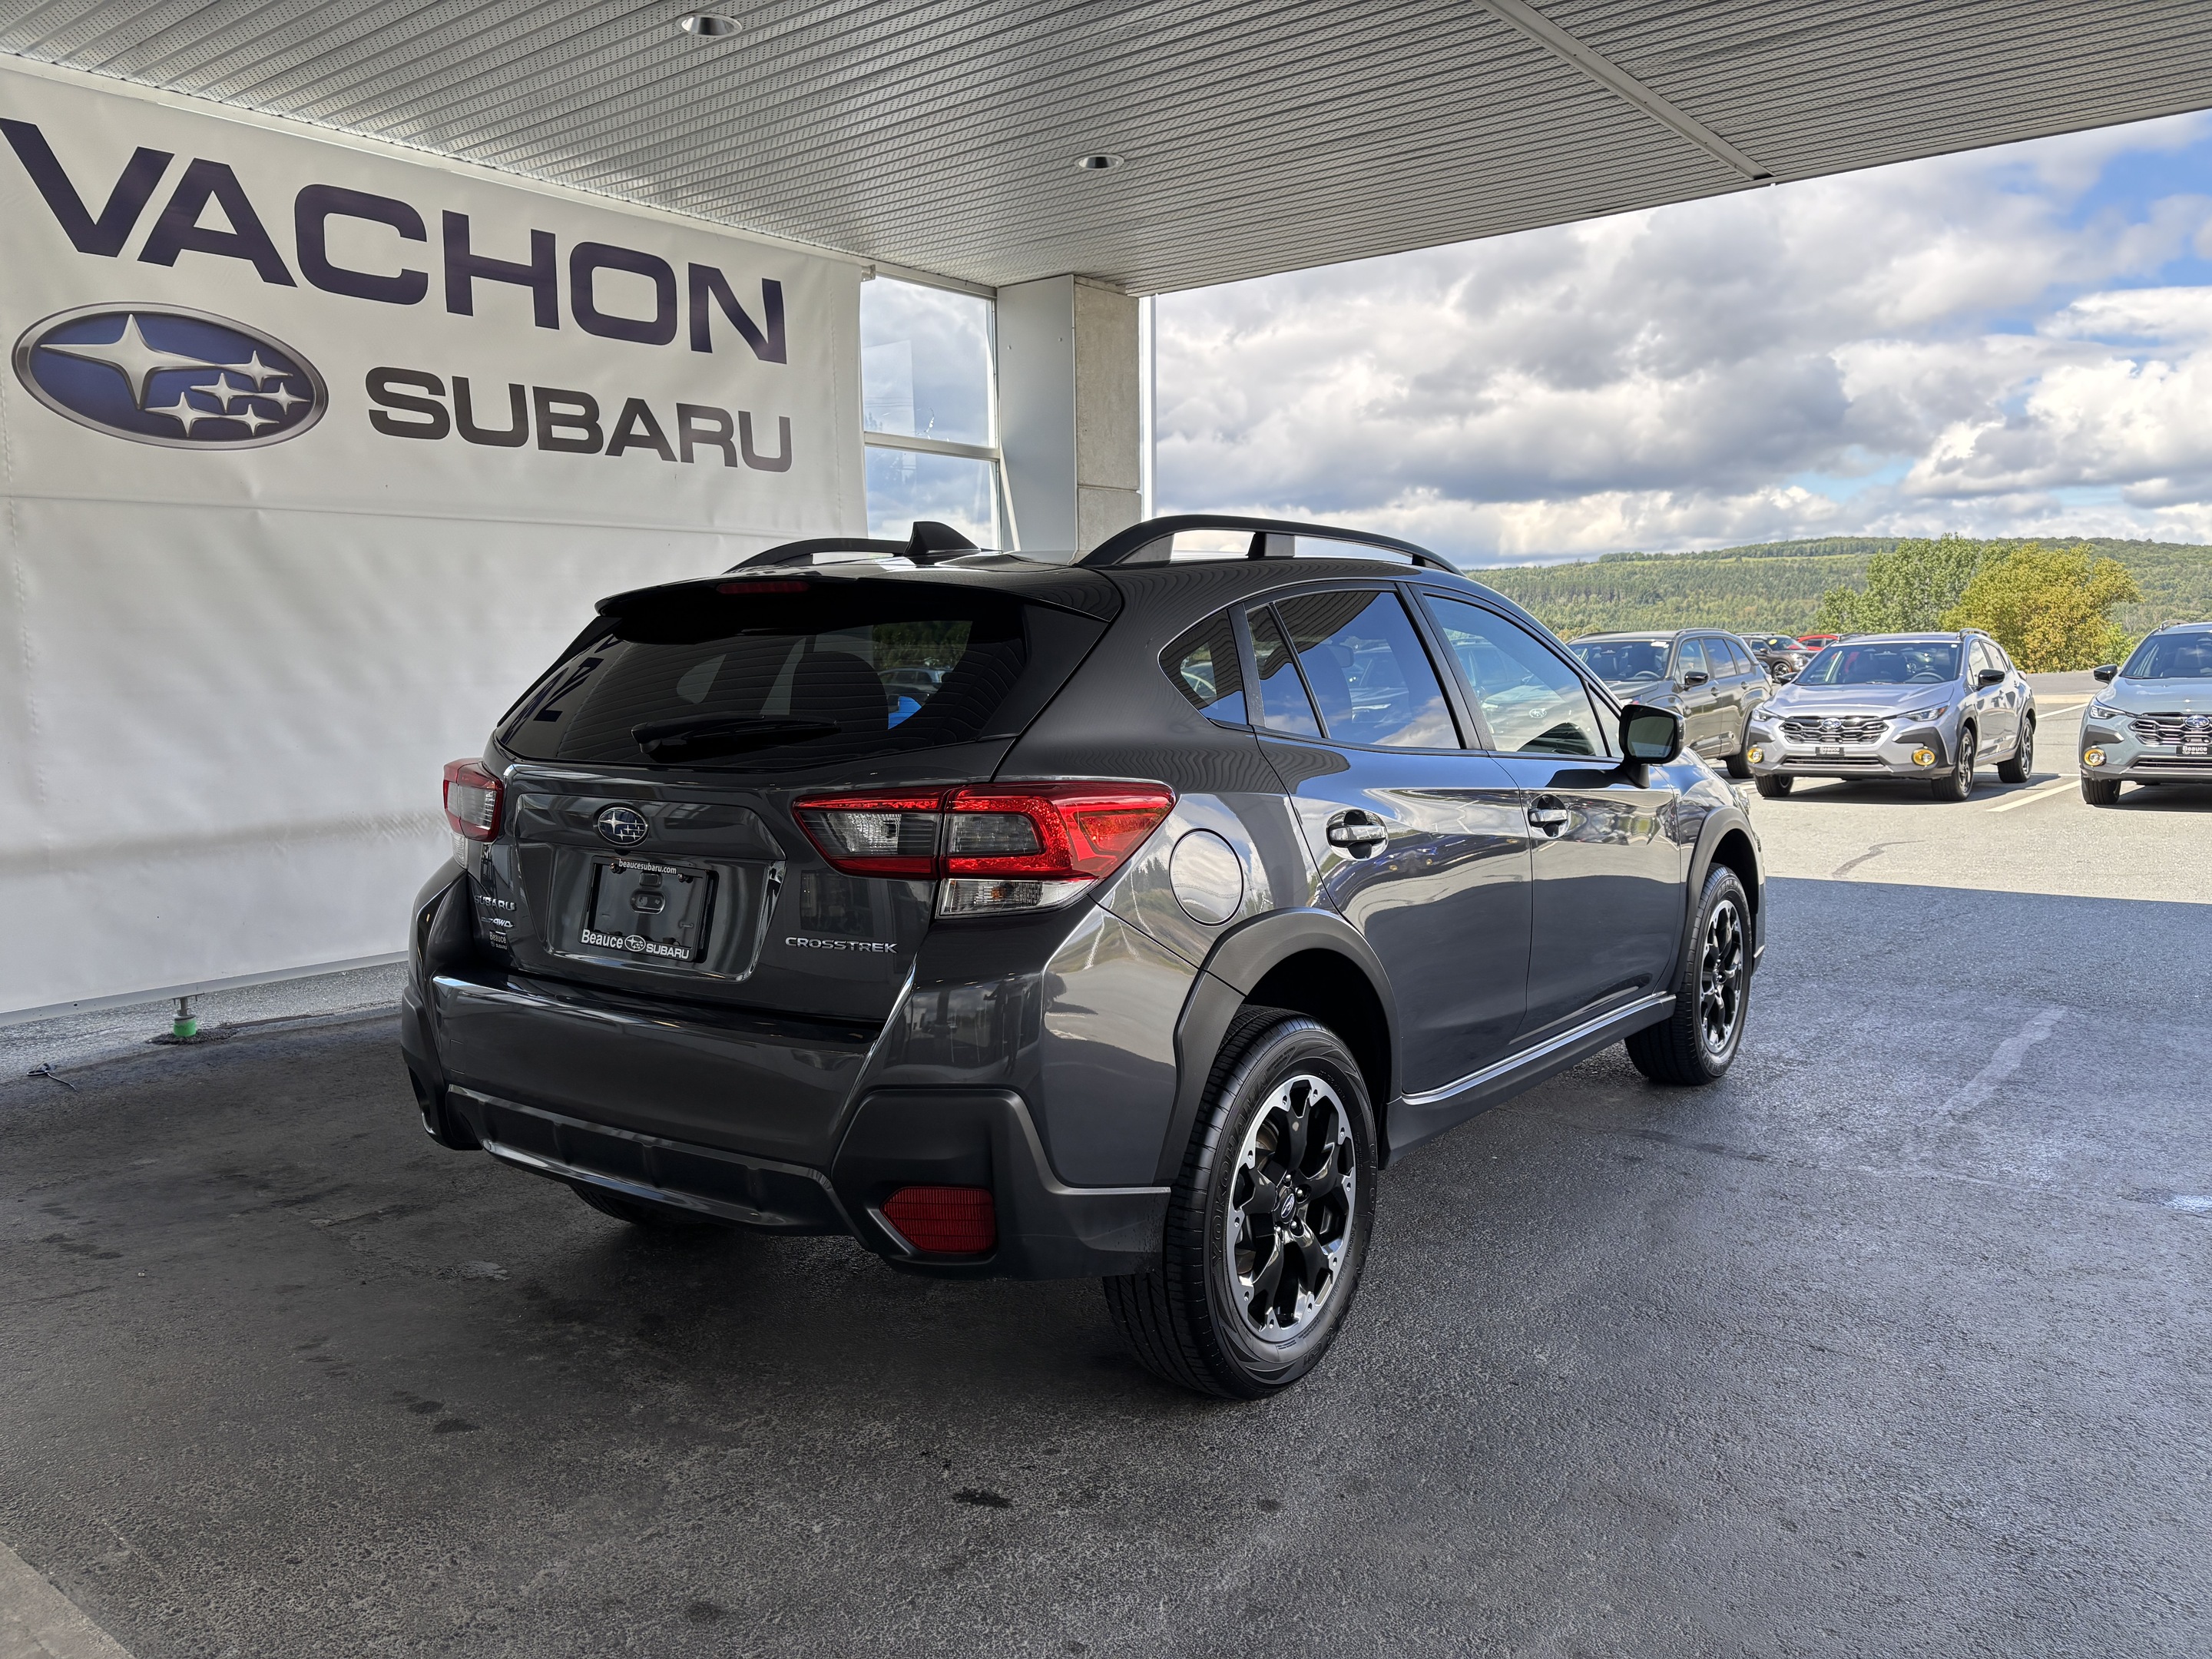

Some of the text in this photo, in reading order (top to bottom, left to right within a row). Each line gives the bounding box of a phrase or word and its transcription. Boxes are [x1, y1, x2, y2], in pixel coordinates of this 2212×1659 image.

[0, 118, 786, 364] VACHON
[365, 366, 791, 472] SUBARU
[618, 858, 677, 875] beaucesubaru.com
[474, 895, 515, 911] SUBARU
[581, 929, 689, 959] Beauce SUBARU
[785, 936, 898, 954] CROSSTREK
